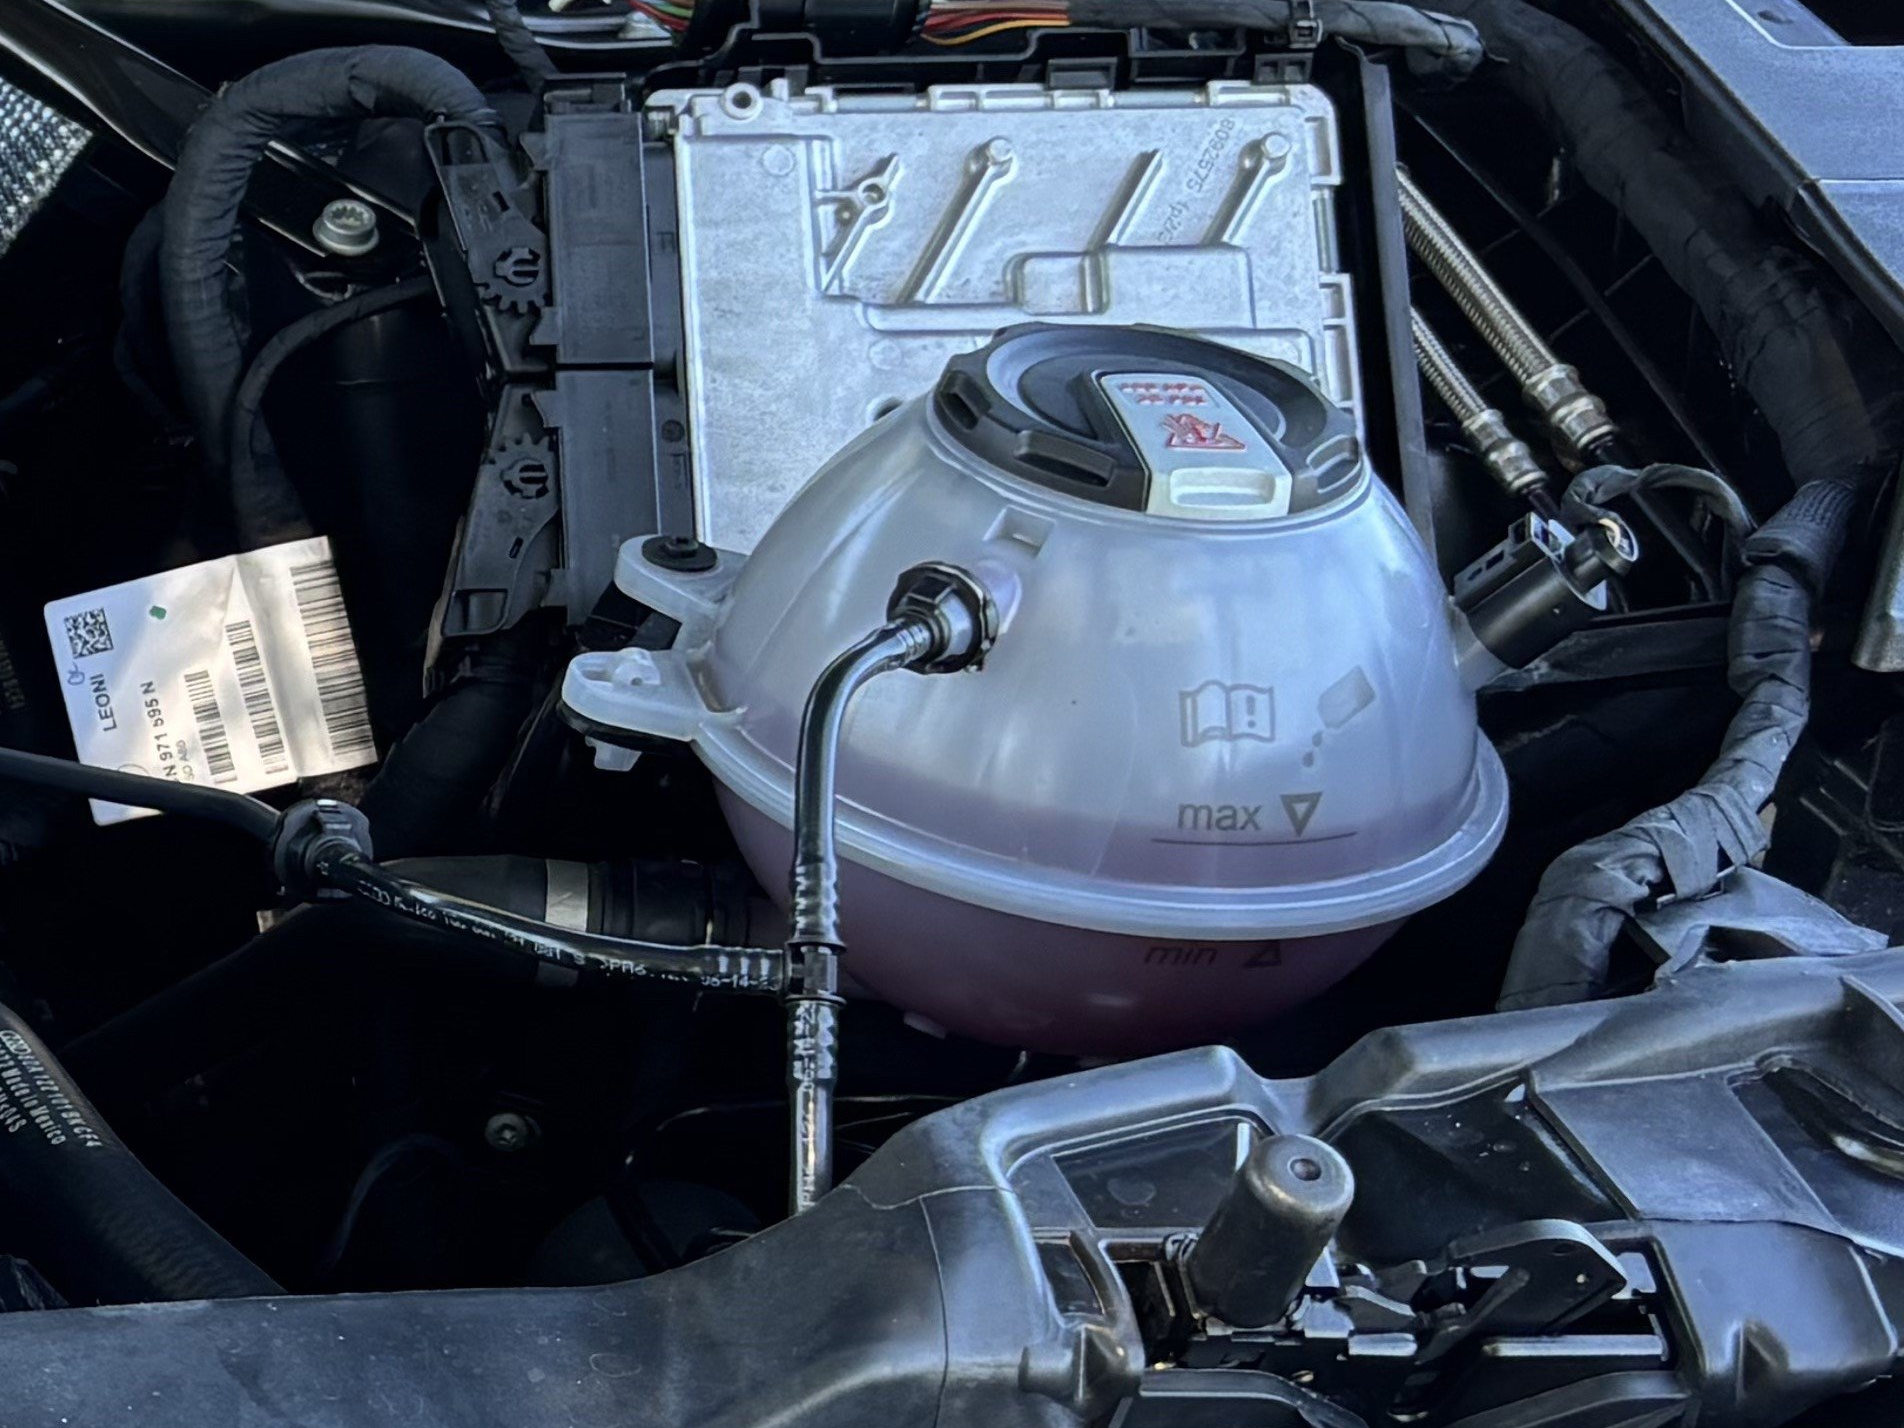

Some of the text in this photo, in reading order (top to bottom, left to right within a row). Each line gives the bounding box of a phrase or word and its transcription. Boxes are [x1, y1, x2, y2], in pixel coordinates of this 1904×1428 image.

[90, 672, 118, 733] LEONI
[140, 680, 156, 695] N
[143, 698, 165, 729] 595
[153, 731, 174, 764] 971
[1176, 800, 1262, 832] max
[1143, 941, 1218, 966] min
